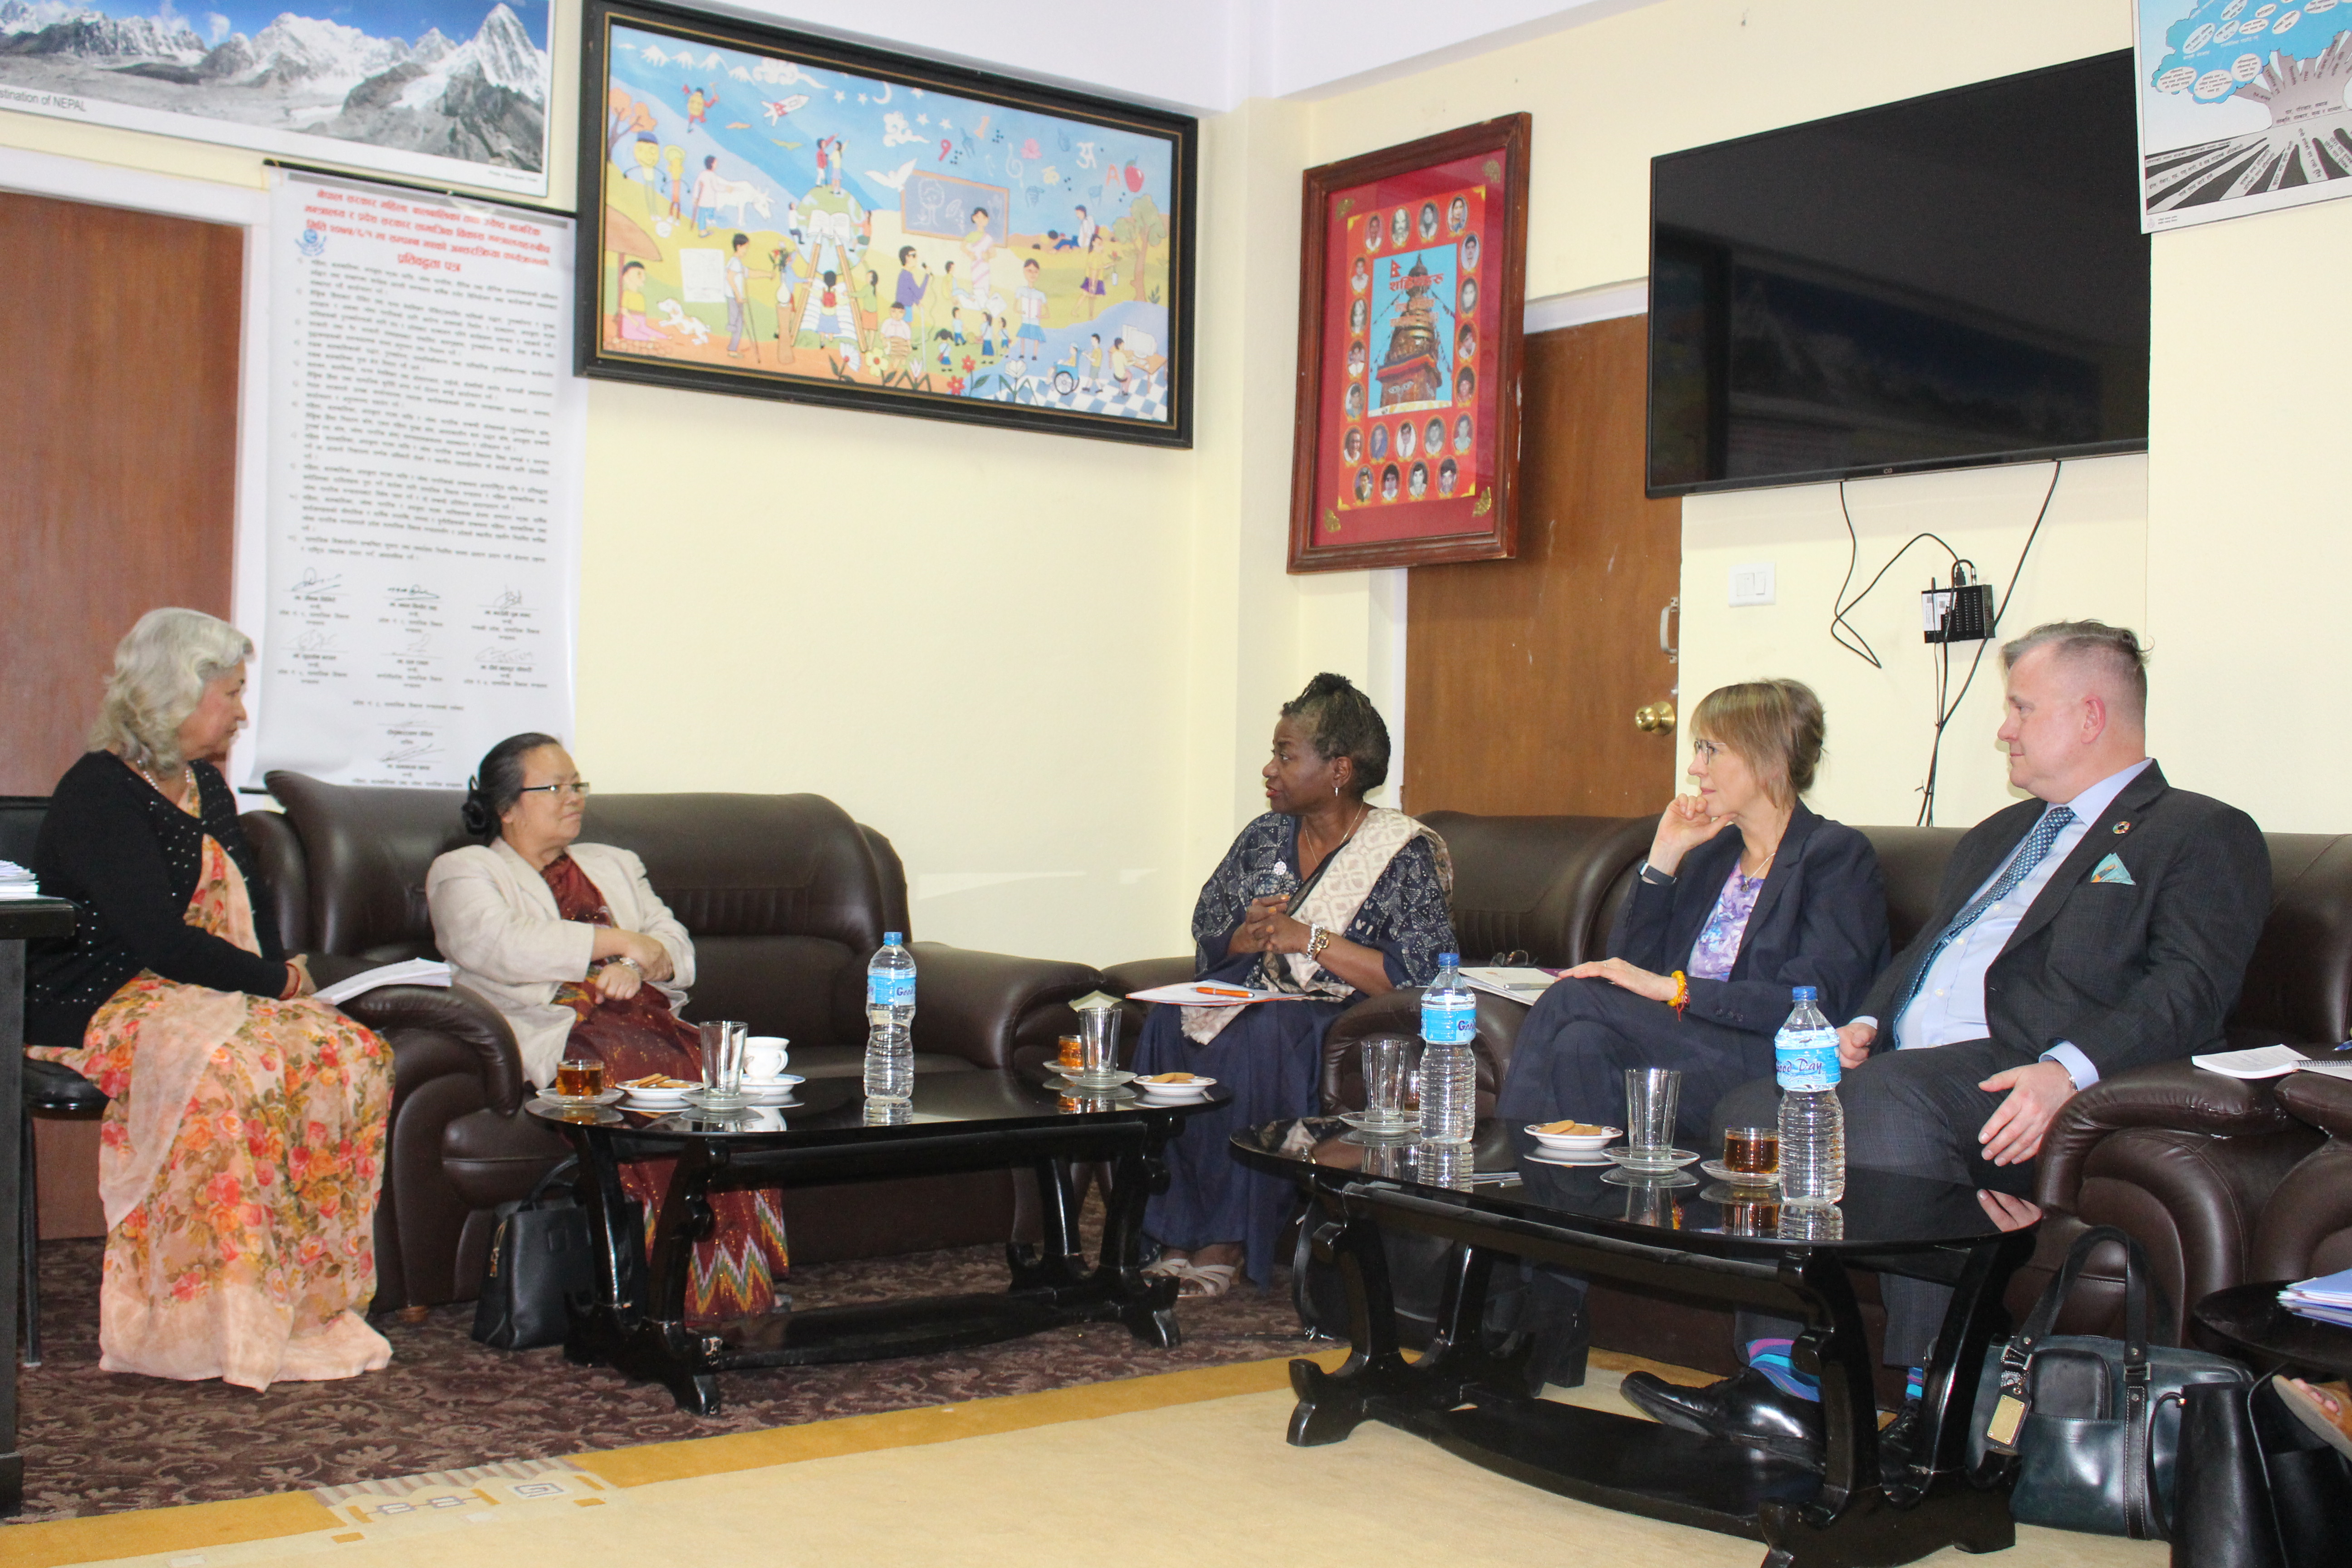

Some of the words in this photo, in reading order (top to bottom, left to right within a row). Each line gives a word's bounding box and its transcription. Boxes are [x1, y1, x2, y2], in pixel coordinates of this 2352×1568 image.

[41, 94, 51, 105] of
[53, 97, 87, 112] NEPAL
[1106, 163, 1122, 186] A
[1795, 1058, 1822, 1074] Day
